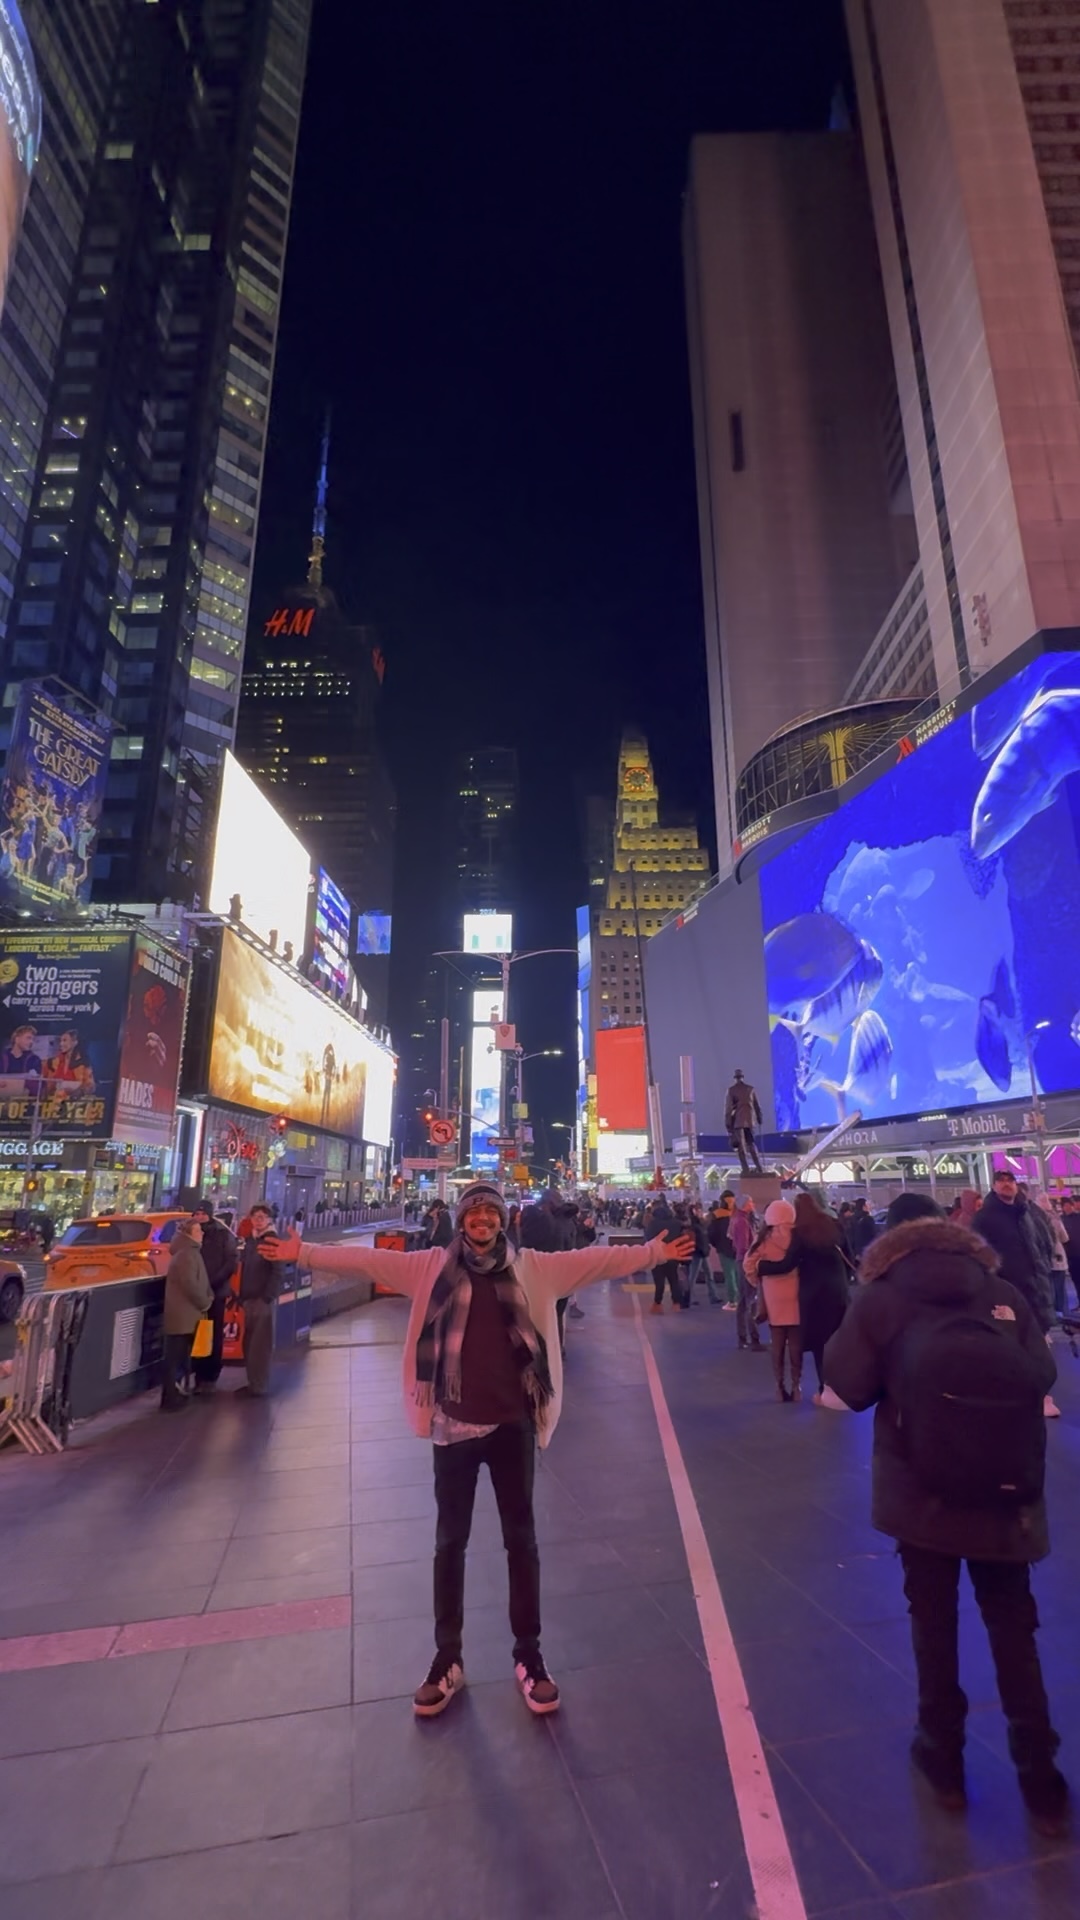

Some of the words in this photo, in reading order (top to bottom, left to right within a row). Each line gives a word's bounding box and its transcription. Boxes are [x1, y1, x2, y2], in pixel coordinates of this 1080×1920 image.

[264, 608, 316, 638] H&M
[915, 699, 957, 737] MARRIOTT
[29, 717, 54, 749] THE
[916, 713, 954, 747] MARQUIS
[34, 744, 90, 788] GATSBY
[55, 738, 101, 777] GREAT
[25, 964, 58, 981] two
[16, 979, 99, 1000] strangers
[11, 997, 32, 1007] carry
[40, 996, 59, 1005] cake
[56, 1004, 73, 1012] new
[73, 1002, 92, 1013] york
[8, 1101, 29, 1119] OF
[960, 1113, 1007, 1136] Mobile
[0, 1141, 64, 1156] GGAGE
[832, 1130, 879, 1148] PHORA
